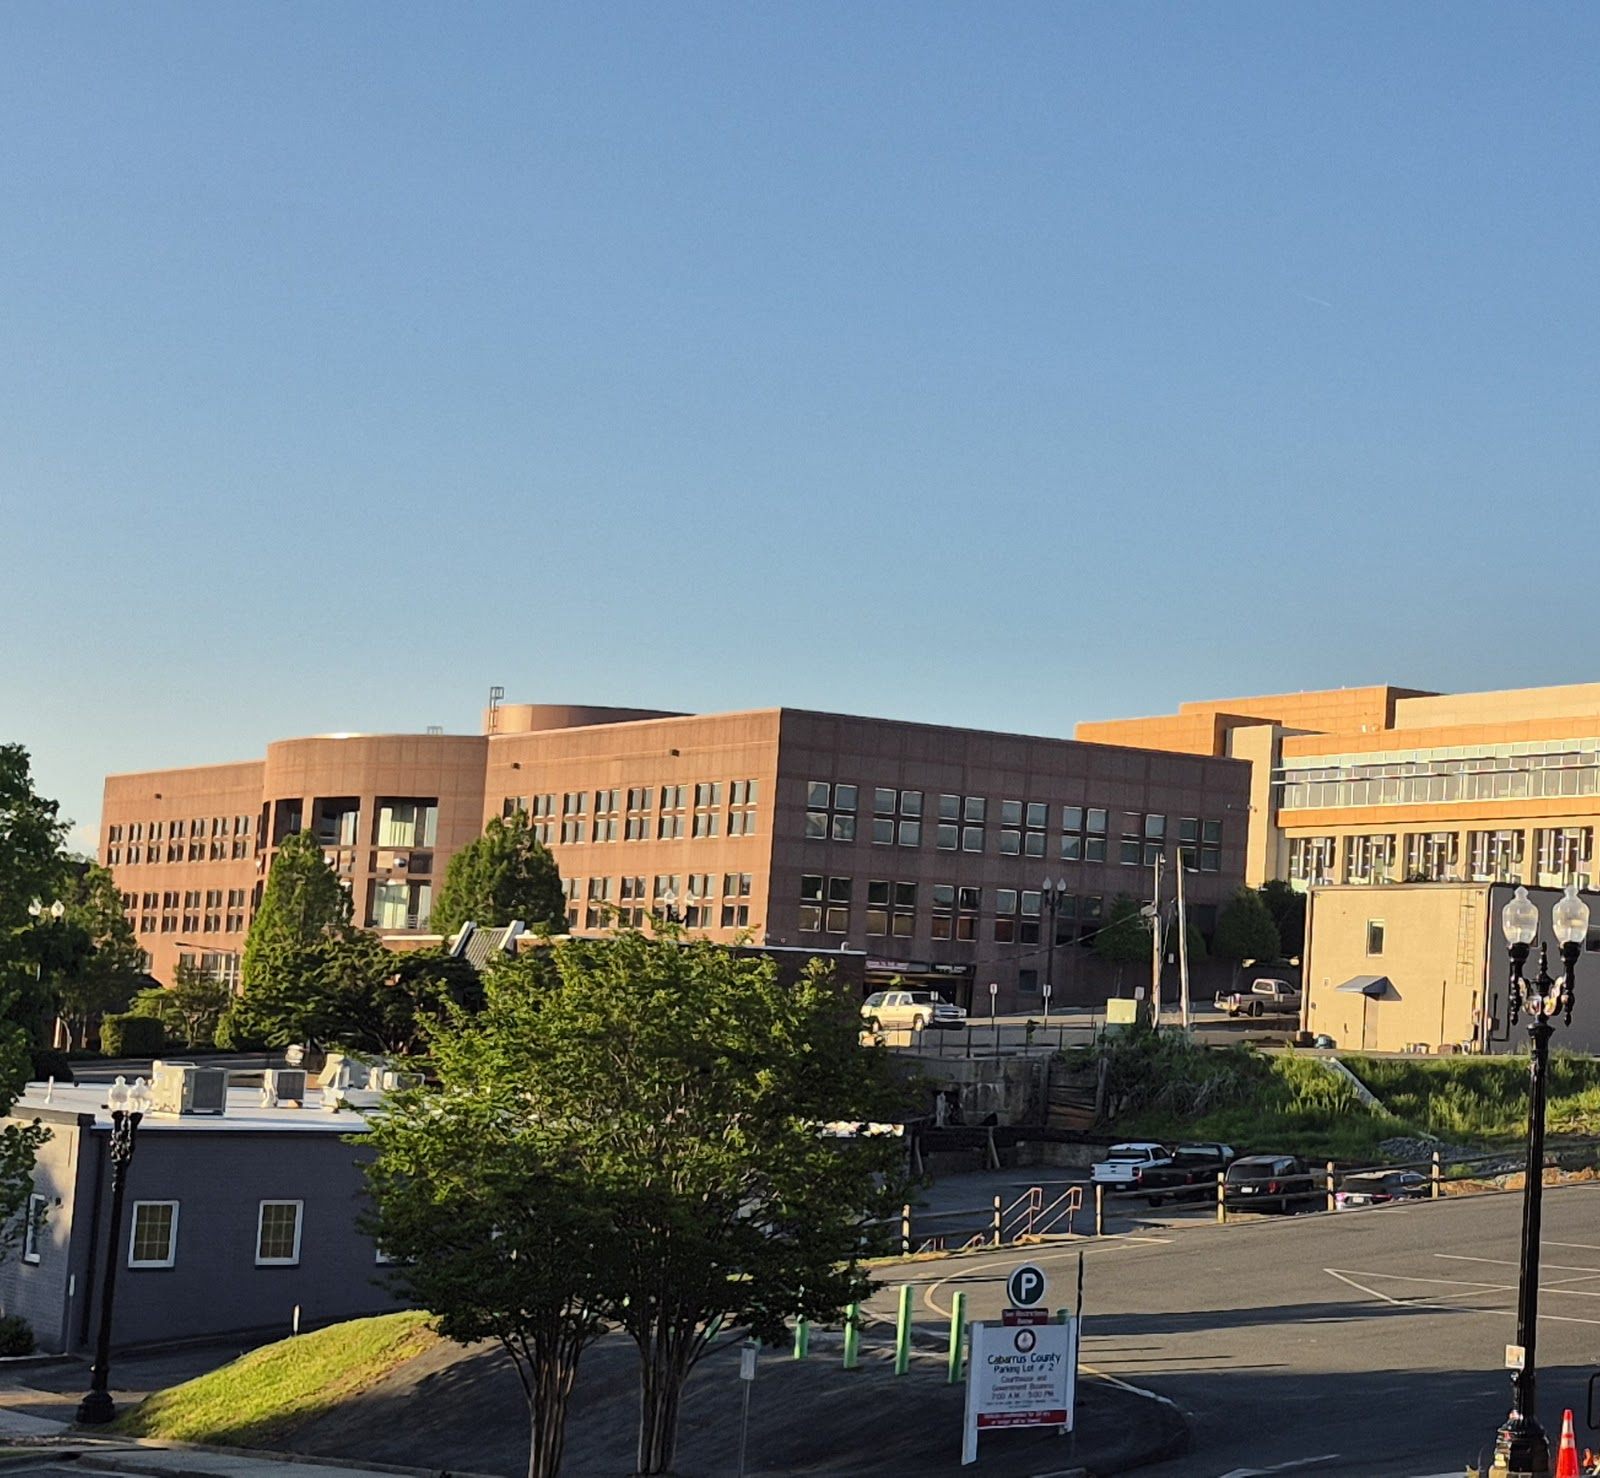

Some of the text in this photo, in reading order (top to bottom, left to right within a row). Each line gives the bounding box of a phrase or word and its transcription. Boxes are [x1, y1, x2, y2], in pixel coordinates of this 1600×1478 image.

[1020, 1273, 1038, 1301] P
[987, 1352, 1061, 1365] Cabarrus County
[994, 1365, 1020, 1374] Parking
[1022, 1364, 1034, 1373] Lot
[1048, 1363, 1054, 1371] 2
[1000, 1376, 1034, 1384] Courthouse
[991, 1384, 1027, 1392] Government
